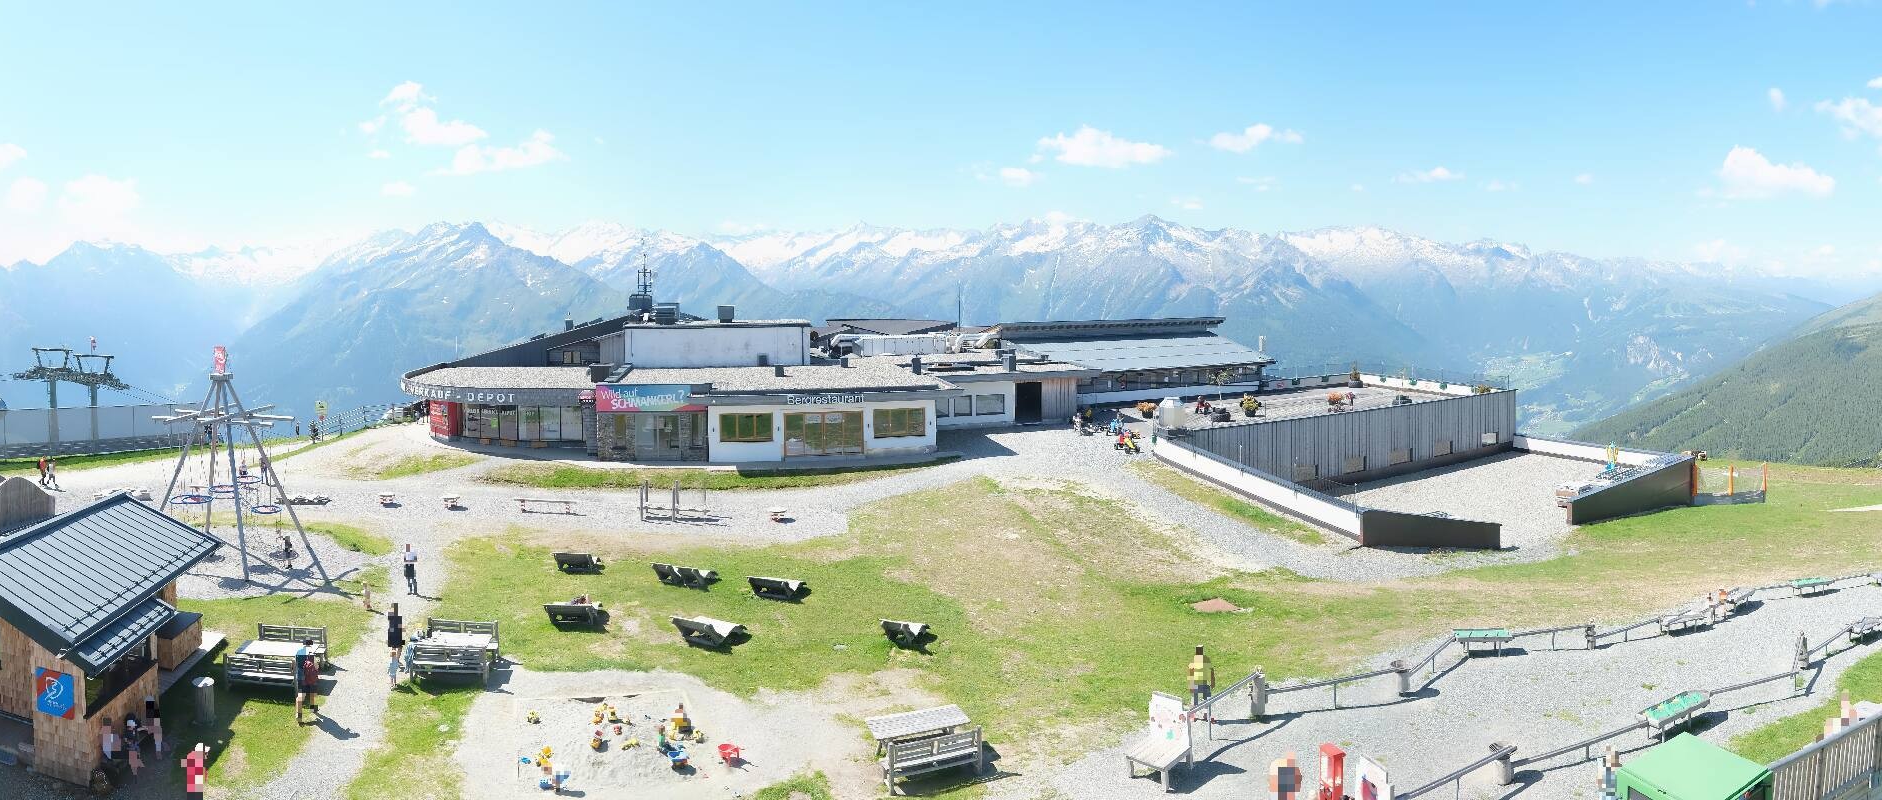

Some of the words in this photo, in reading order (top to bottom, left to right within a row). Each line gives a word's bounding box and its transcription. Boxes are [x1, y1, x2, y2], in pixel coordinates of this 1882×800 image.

[410, 386, 452, 400] VERKAUF
[467, 393, 516, 403] DEPOT
[600, 389, 621, 400] Wild
[623, 387, 638, 397] auf
[787, 394, 865, 405] Bergrestaurant
